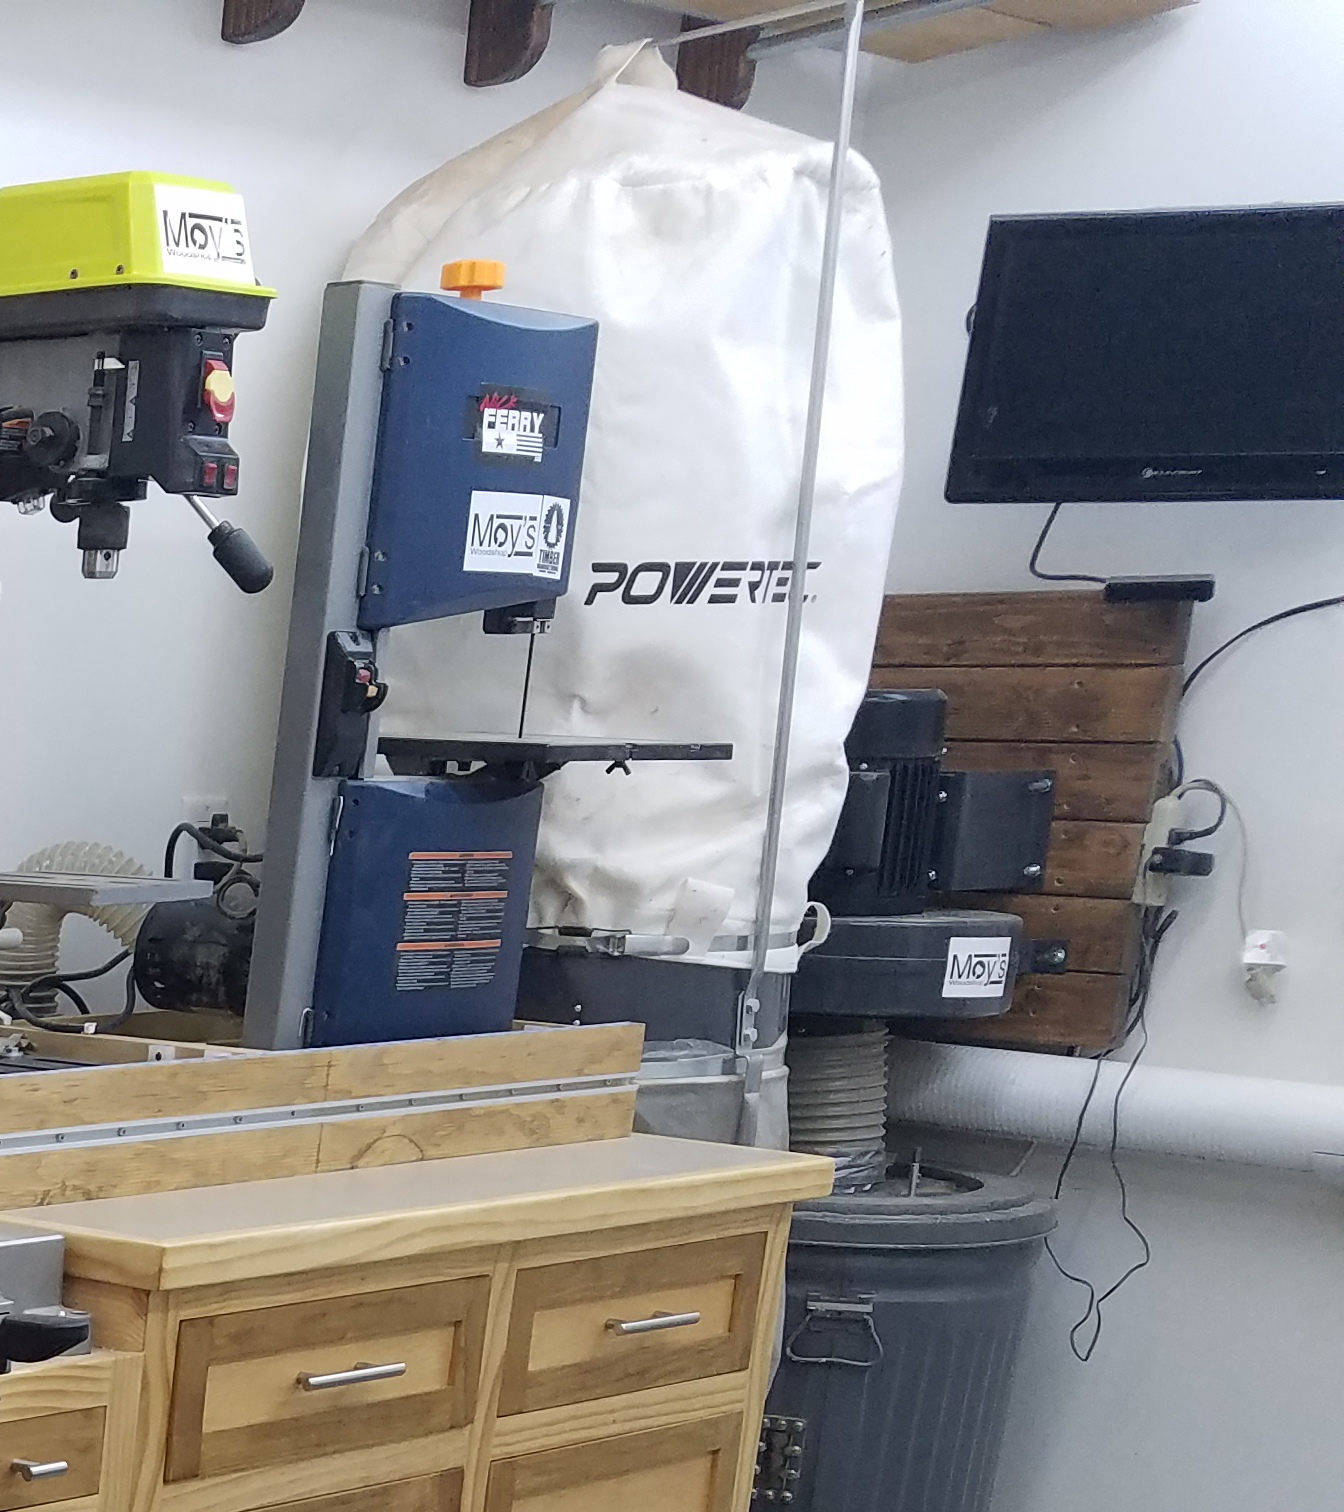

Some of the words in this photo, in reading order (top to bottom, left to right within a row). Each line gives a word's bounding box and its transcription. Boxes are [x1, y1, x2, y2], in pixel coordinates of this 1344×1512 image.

[482, 407, 545, 434] FERRY
[470, 512, 537, 558] Moy's
[949, 953, 1007, 986] Moy's
